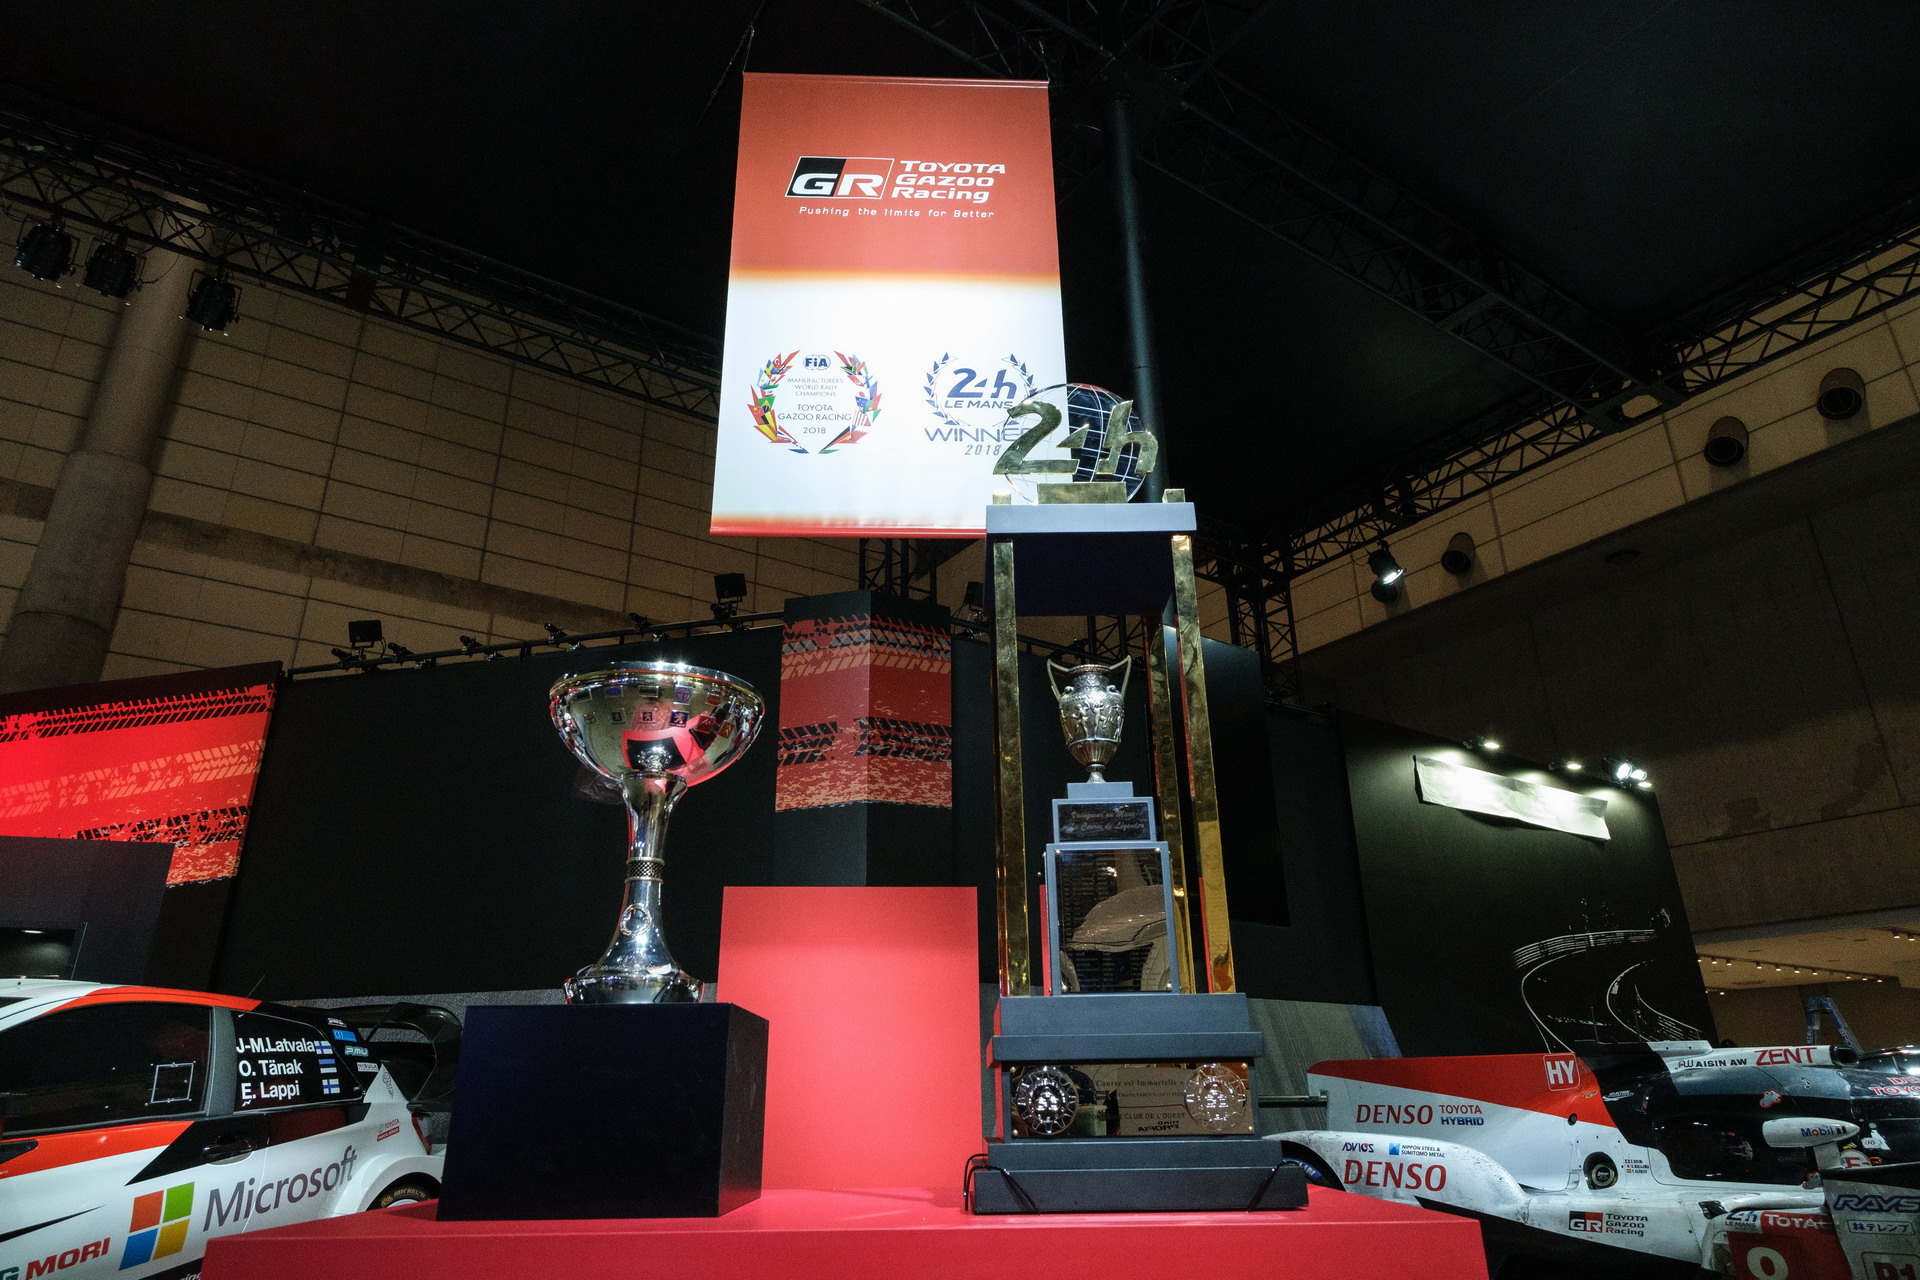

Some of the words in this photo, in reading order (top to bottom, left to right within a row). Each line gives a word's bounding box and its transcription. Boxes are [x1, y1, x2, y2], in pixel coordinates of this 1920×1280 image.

[900, 160, 1006, 174] TOYOTA
[792, 173, 884, 197] GR
[895, 173, 995, 187] GAZOO
[891, 187, 990, 203] Racing
[799, 206, 850, 218] Pushing
[857, 206, 878, 217] the
[883, 208, 921, 218] limits
[928, 208, 947, 218] for
[953, 209, 994, 219] Better
[947, 368, 1017, 399] 24h
[944, 400, 964, 409] LE
[967, 400, 1013, 409] MANS
[778, 413, 814, 421] GAZOO
[815, 413, 852, 421] RACING
[964, 444, 1001, 456] 2018
[1695, 1059, 1727, 1068] AISIN
[1730, 1058, 1747, 1066] AW
[1754, 1047, 1817, 1066] ZENT
[238, 1060, 256, 1077] O.
[258, 1059, 304, 1076] Tänak
[1546, 1060, 1575, 1085] HY
[241, 1083, 257, 1099] E.
[260, 1080, 300, 1100] Lappi
[1356, 1104, 1433, 1124] DENSO
[1439, 1105, 1483, 1114] TOYOTA
[1441, 1117, 1485, 1125] HYBRID
[1800, 1126, 1834, 1137] Mobil
[1344, 1159, 1447, 1192] DENSO
[202, 1145, 358, 1232] Microsoft
[1833, 1194, 1920, 1213] RAYS
[1606, 1213, 1649, 1222] TOYOTA
[1606, 1220, 1645, 1229] GAZOO
[1569, 1218, 1603, 1233] GR
[1606, 1228, 1644, 1237] Racing
[26, 1237, 111, 1280] MORI
